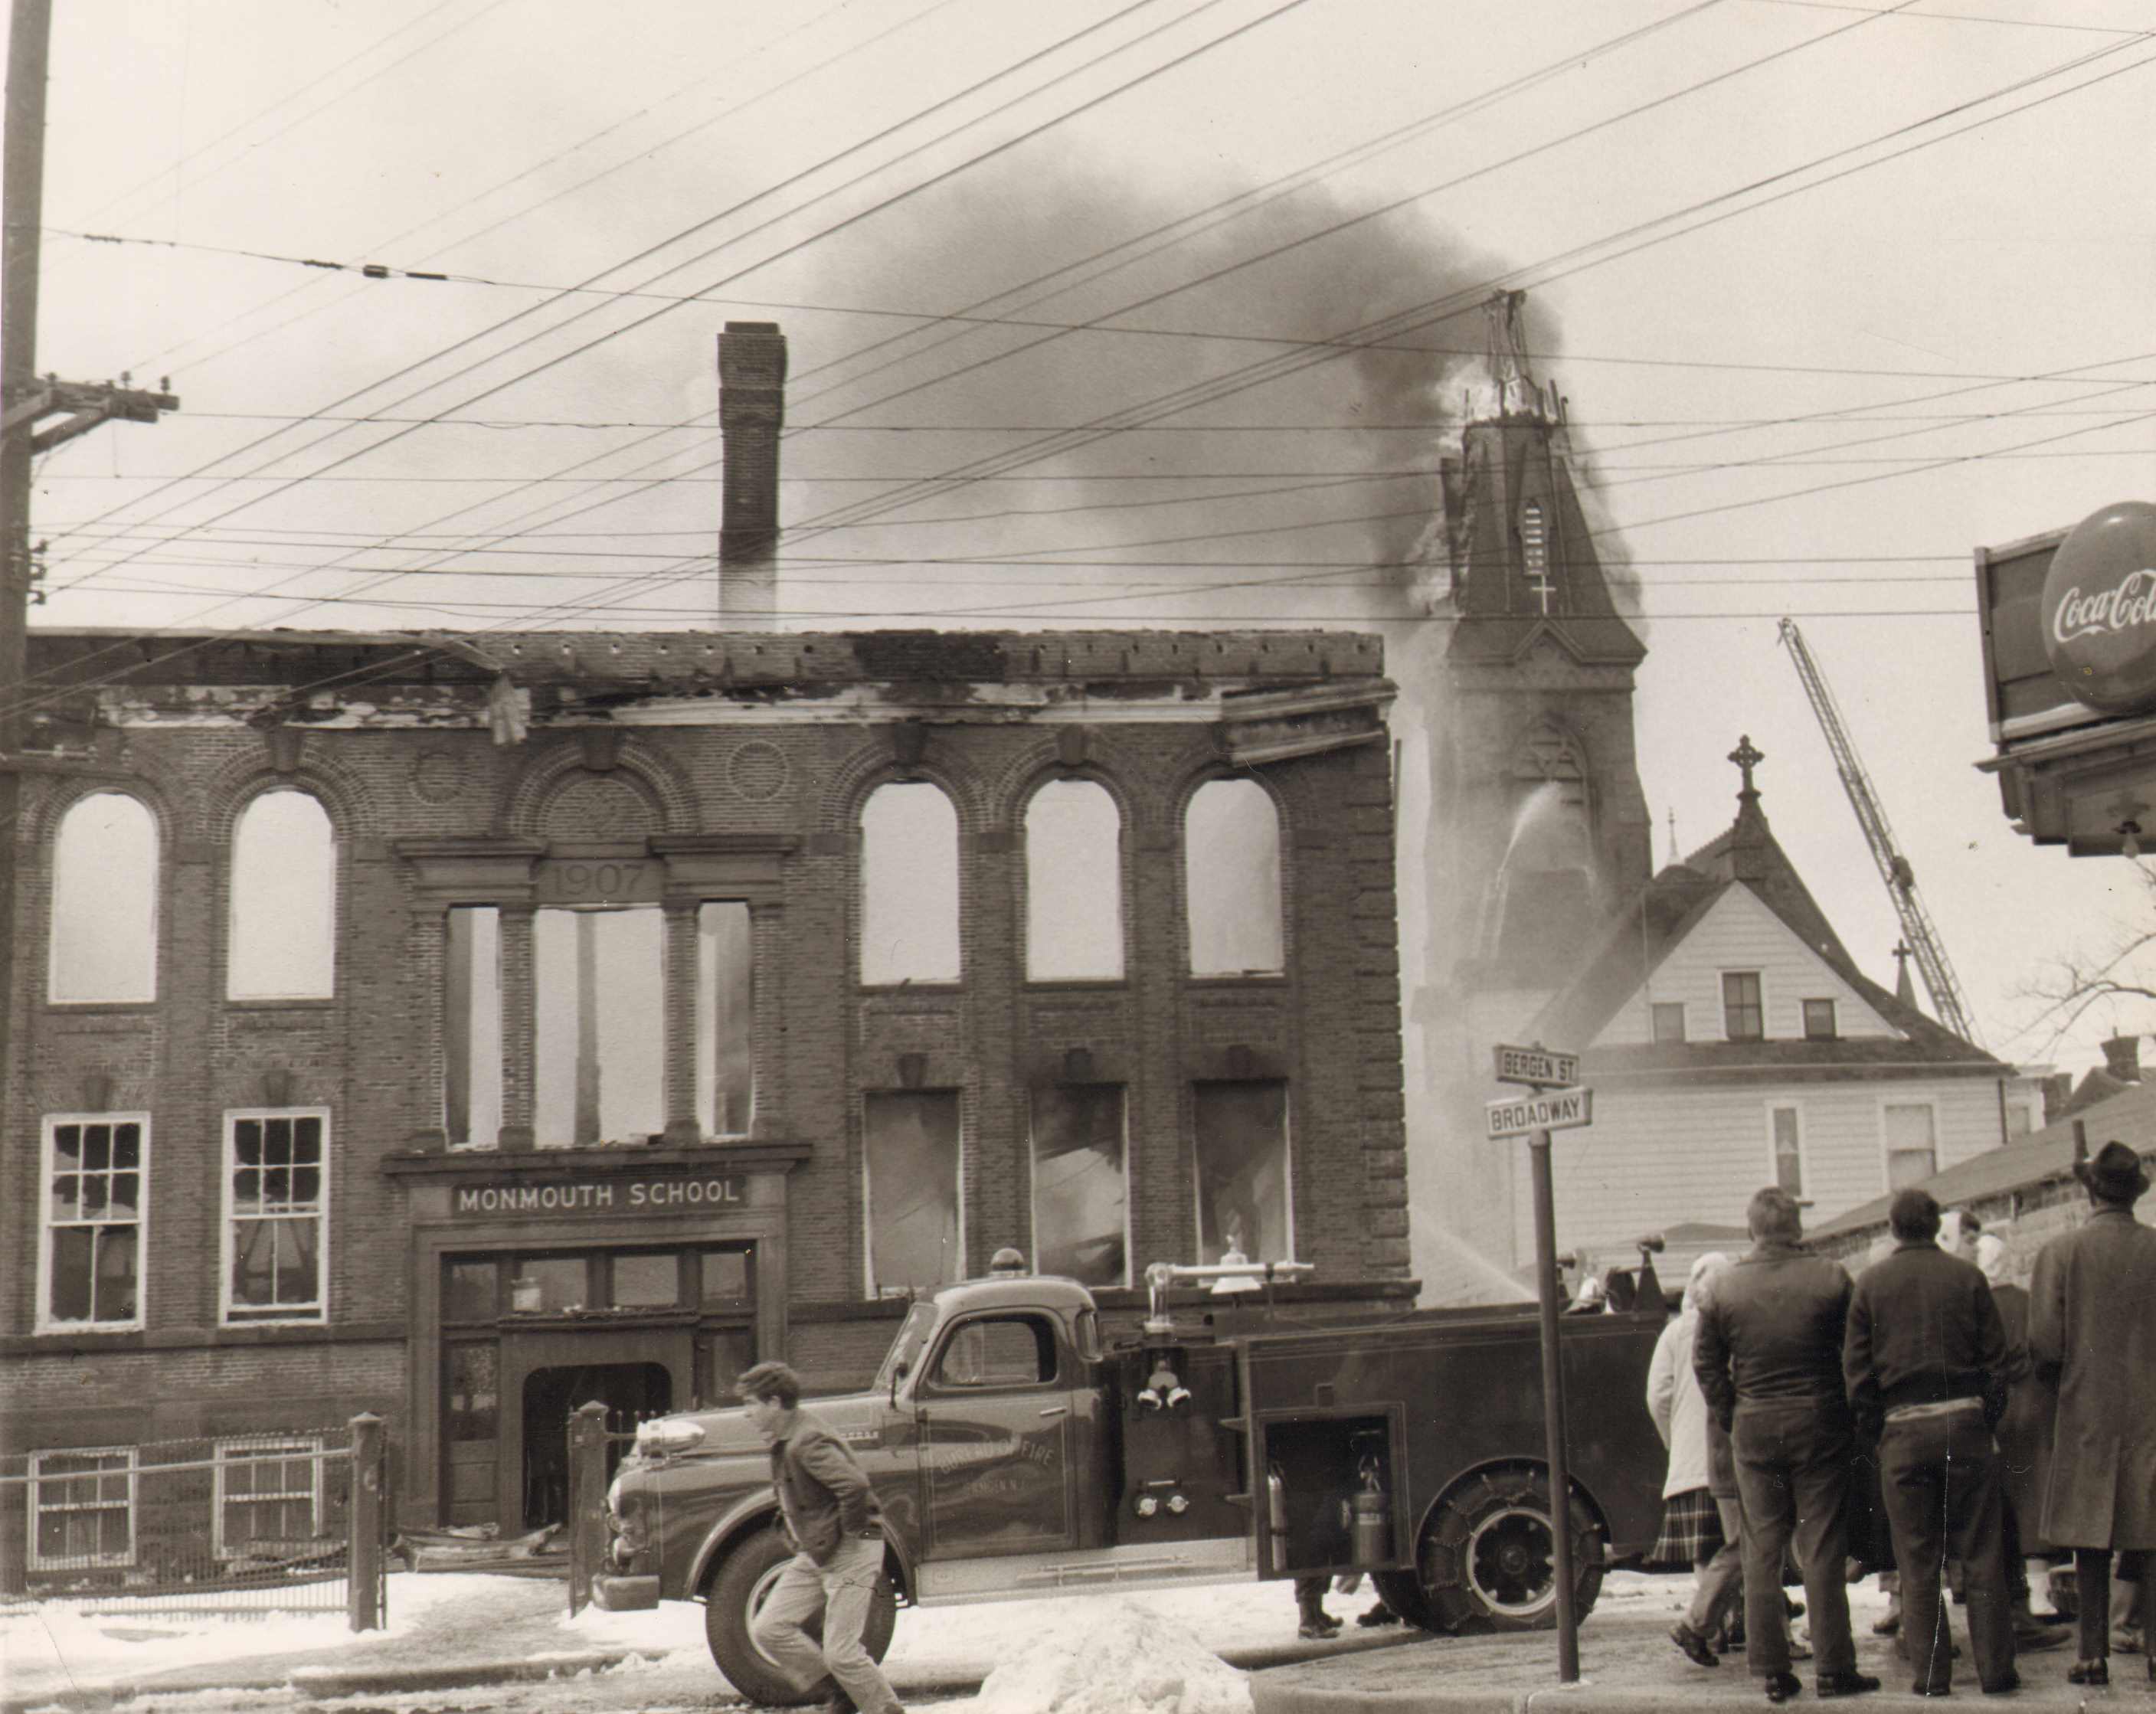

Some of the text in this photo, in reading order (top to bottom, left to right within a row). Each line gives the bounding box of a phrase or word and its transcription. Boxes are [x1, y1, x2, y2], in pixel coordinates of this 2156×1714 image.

[2054, 569, 2156, 643] Coca-Col
[553, 863, 645, 896] 1907
[1504, 1052, 1553, 1078] BERGEN
[1491, 1097, 1580, 1131] BROADWAY
[460, 1180, 739, 1212] MONMOUTH SCHOOL
[1021, 1440, 1055, 1465] FIRE
